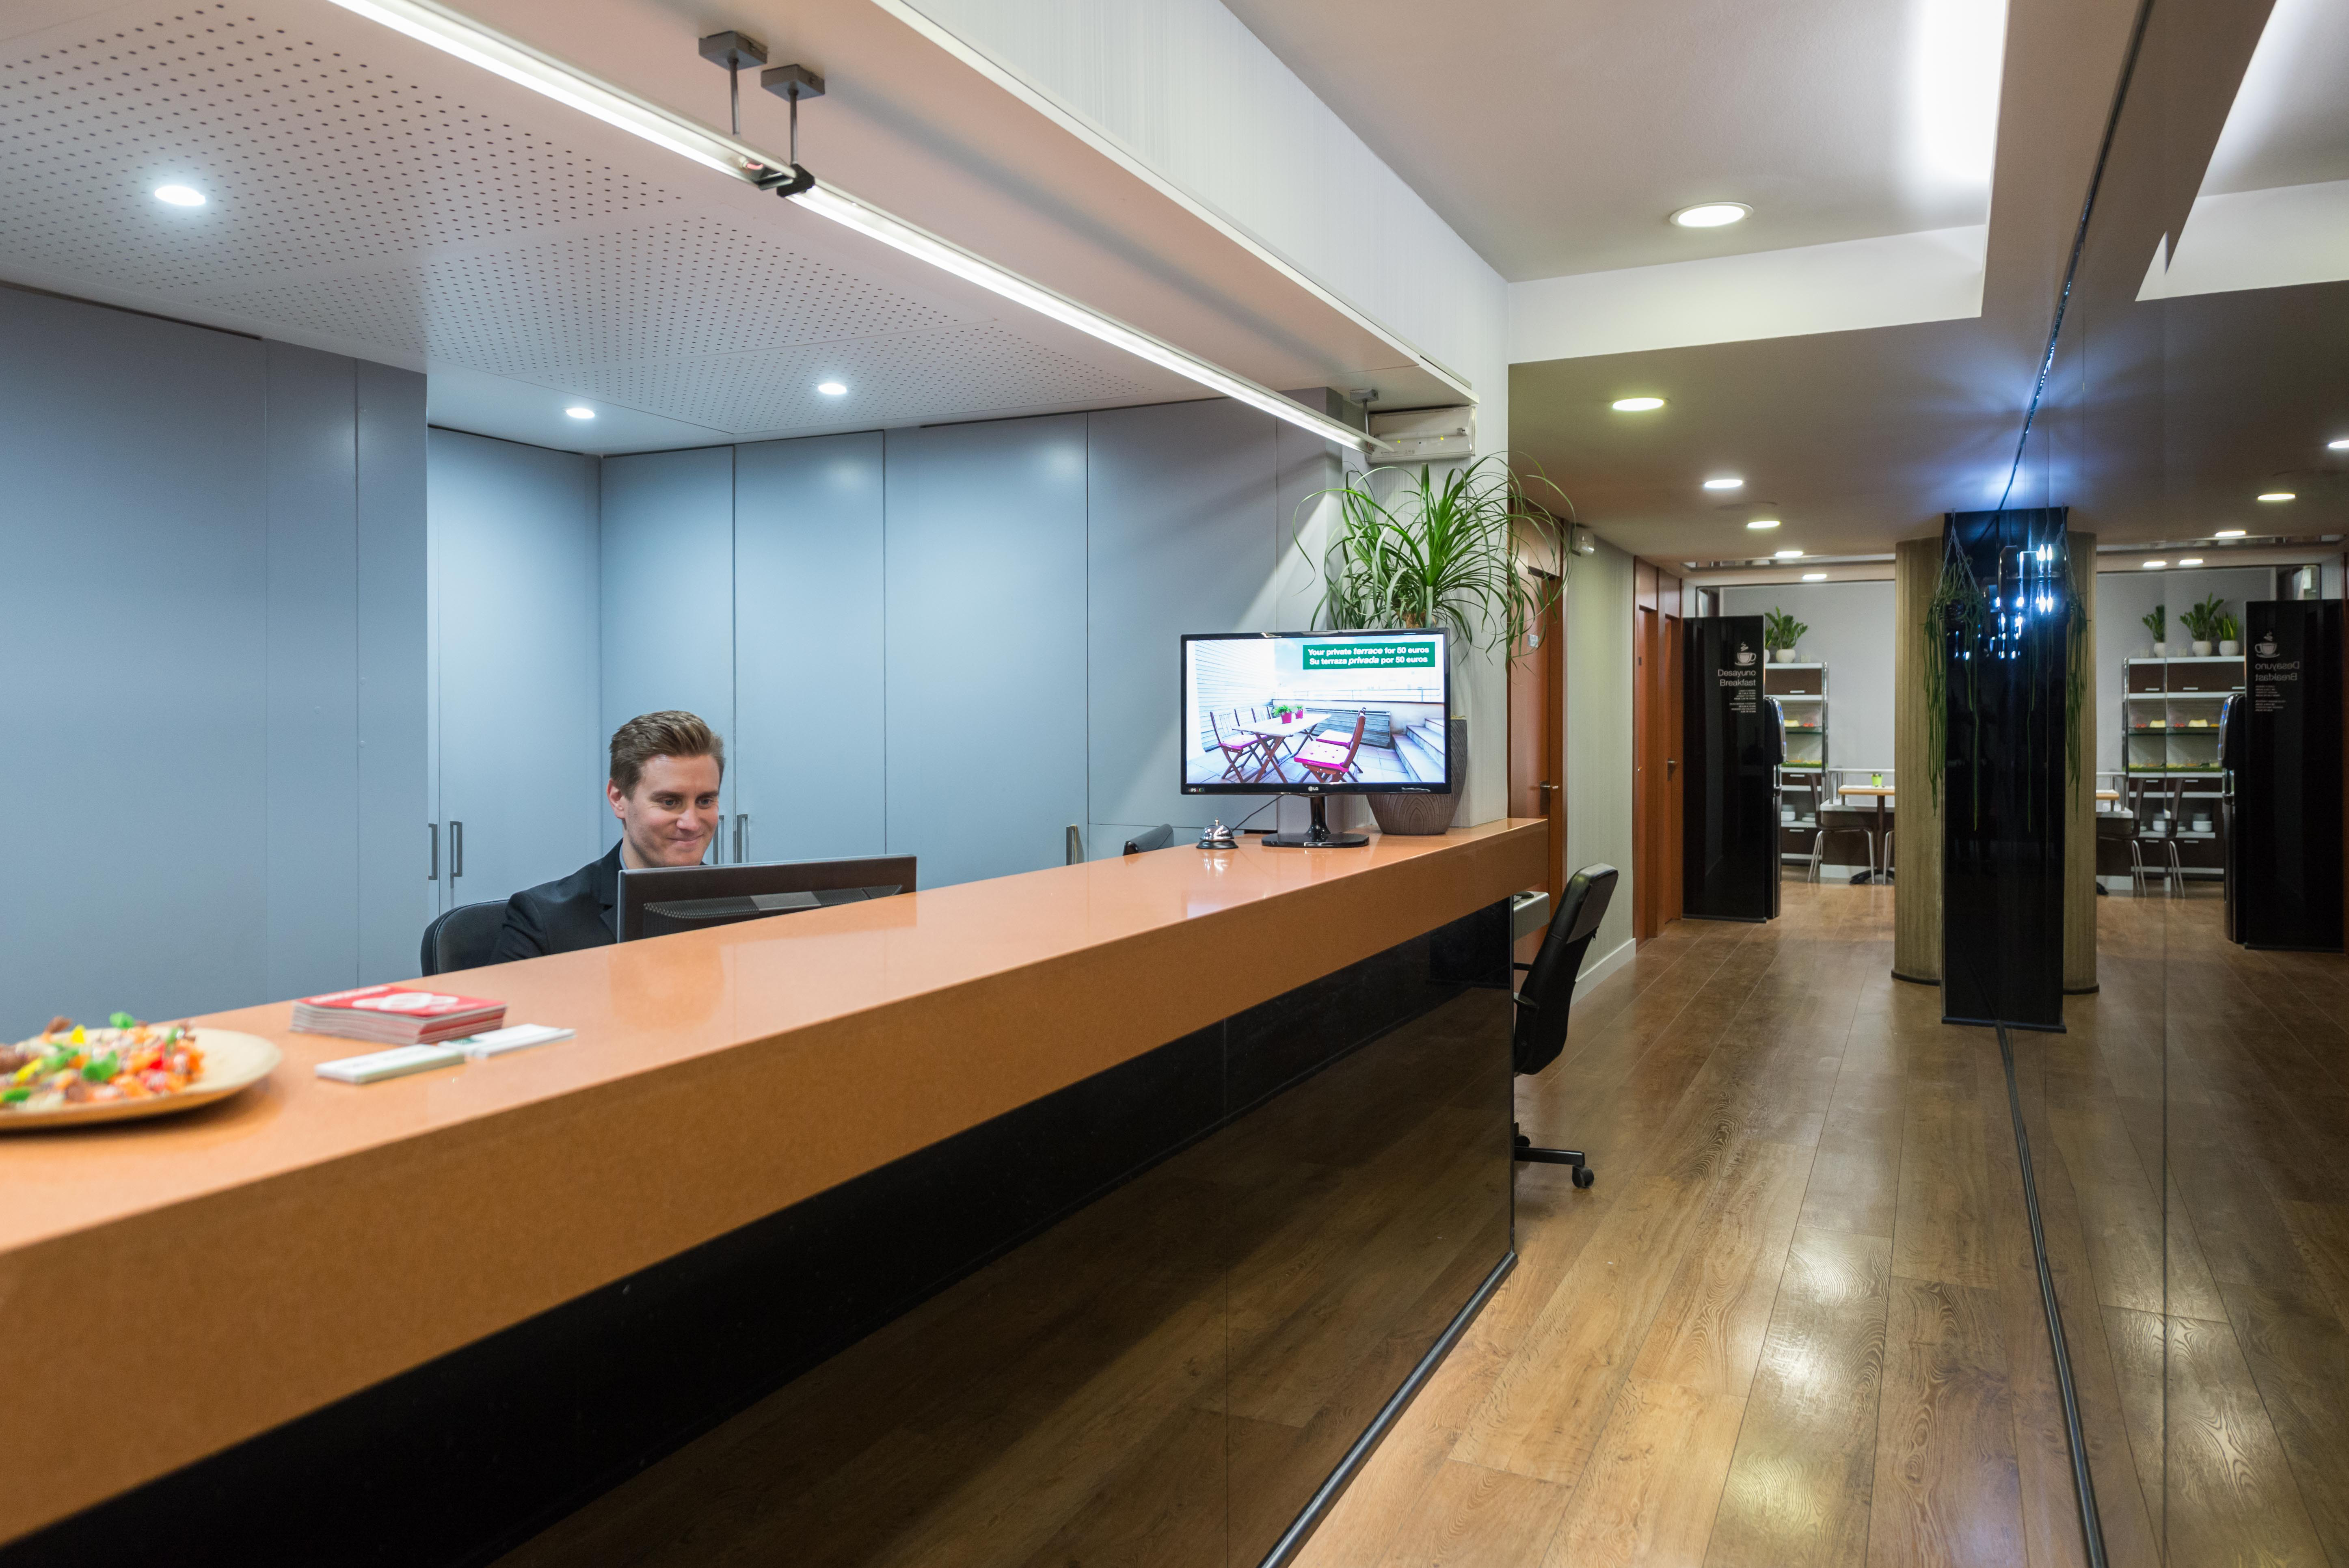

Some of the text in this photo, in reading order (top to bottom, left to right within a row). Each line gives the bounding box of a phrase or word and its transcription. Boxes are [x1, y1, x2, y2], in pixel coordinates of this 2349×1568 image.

[1326, 648, 1352, 657] private
[1348, 657, 1379, 665] privada
[1718, 669, 1756, 678] Desayuno
